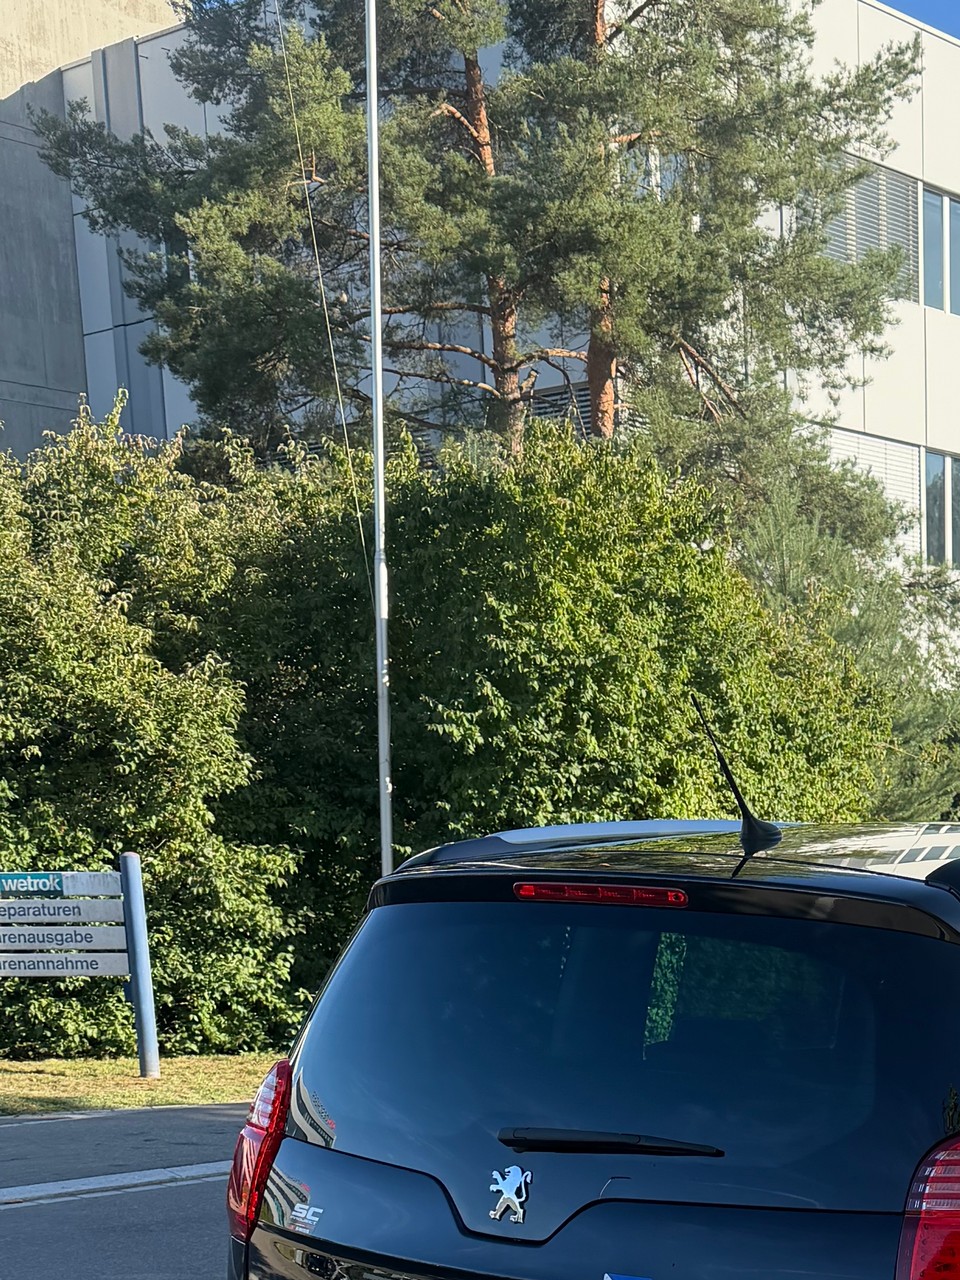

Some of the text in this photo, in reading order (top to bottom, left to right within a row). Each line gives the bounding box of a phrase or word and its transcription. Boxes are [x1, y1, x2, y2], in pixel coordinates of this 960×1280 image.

[2, 875, 62, 892] wetrok
[0, 930, 94, 946] renausgabe
[0, 957, 99, 970] renannahme
[291, 1203, 324, 1222] SC
